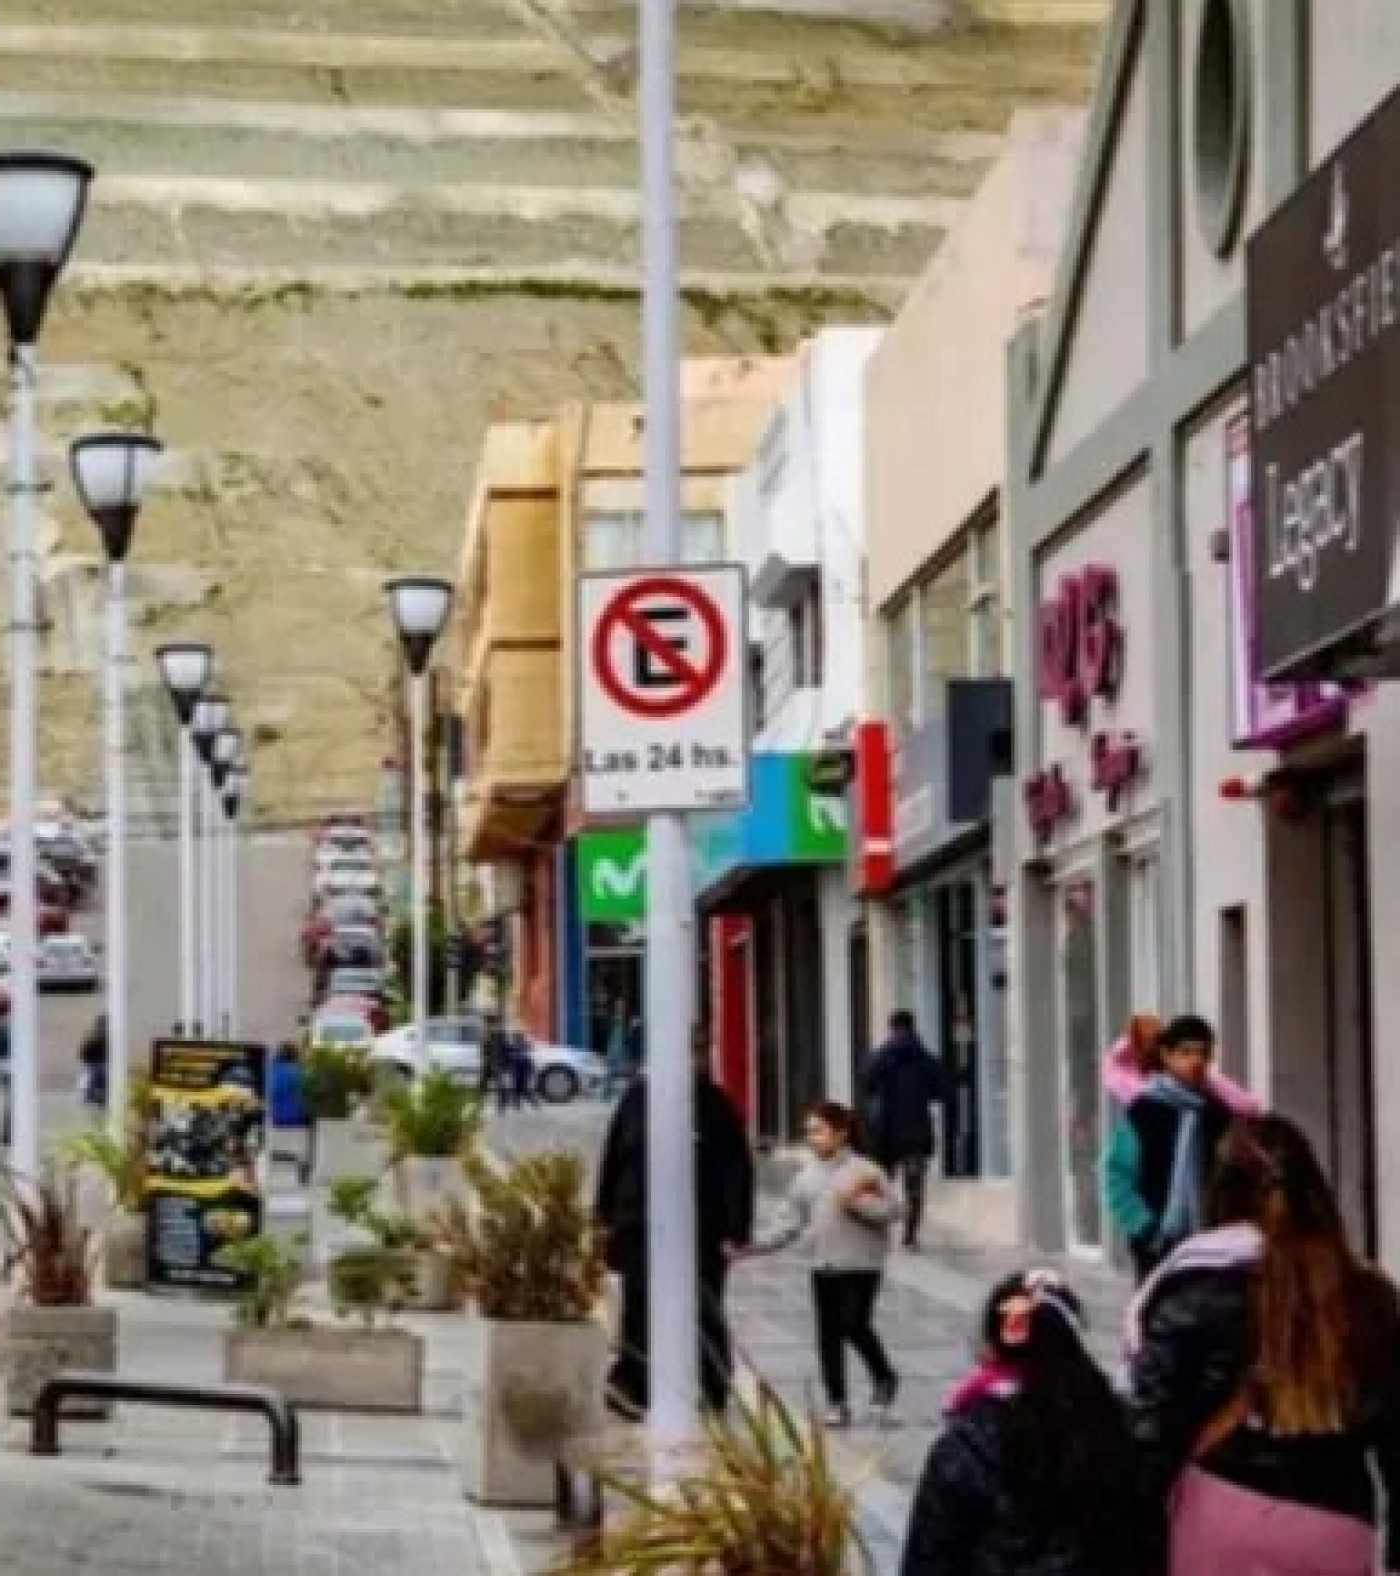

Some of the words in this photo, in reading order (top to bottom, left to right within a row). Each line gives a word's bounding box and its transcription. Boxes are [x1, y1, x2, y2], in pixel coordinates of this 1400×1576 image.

[1253, 236, 1400, 431] BROOKSFIE
[583, 746, 639, 773] Las
[646, 740, 683, 772] 24
